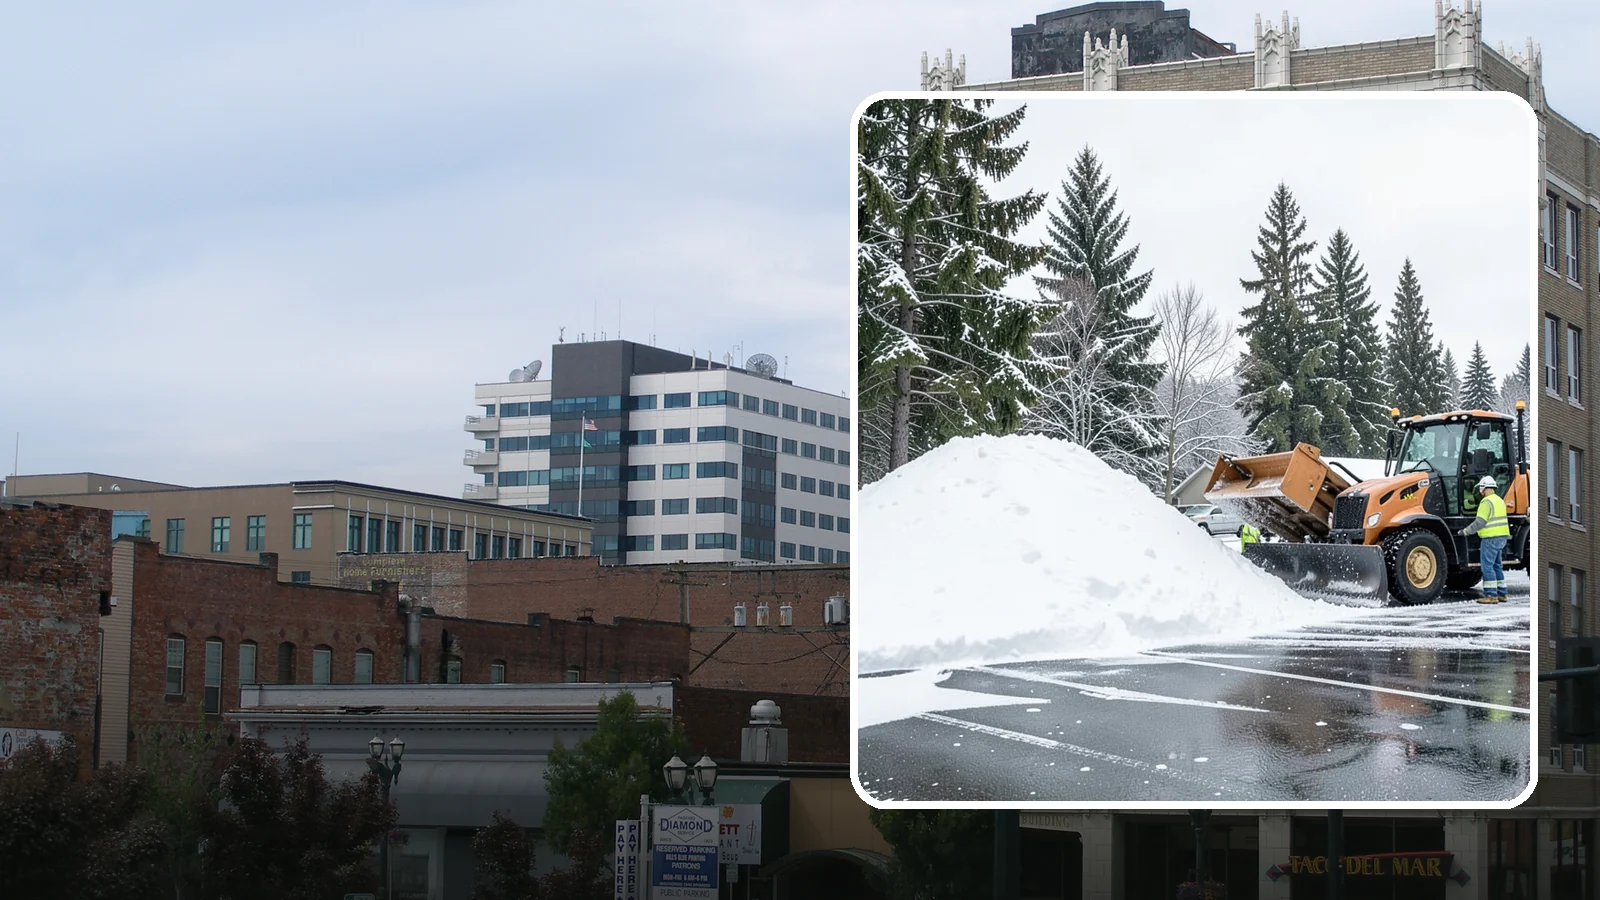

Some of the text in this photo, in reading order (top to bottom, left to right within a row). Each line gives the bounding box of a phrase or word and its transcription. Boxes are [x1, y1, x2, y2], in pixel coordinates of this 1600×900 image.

[343, 566, 427, 577] Home Furnishers
[660, 818, 713, 832] DIAMOND
[1022, 815, 1069, 828] BUILDING
[656, 845, 716, 854] RESERVED PARKING
[616, 824, 625, 894] PAY HERE
[627, 824, 637, 894] PAY HERE
[721, 851, 739, 862] Soup
[671, 862, 701, 870] PATRONS
[1289, 855, 1443, 877] TAC DEL MAR
[660, 888, 710, 898] PUBLIC PARKING
